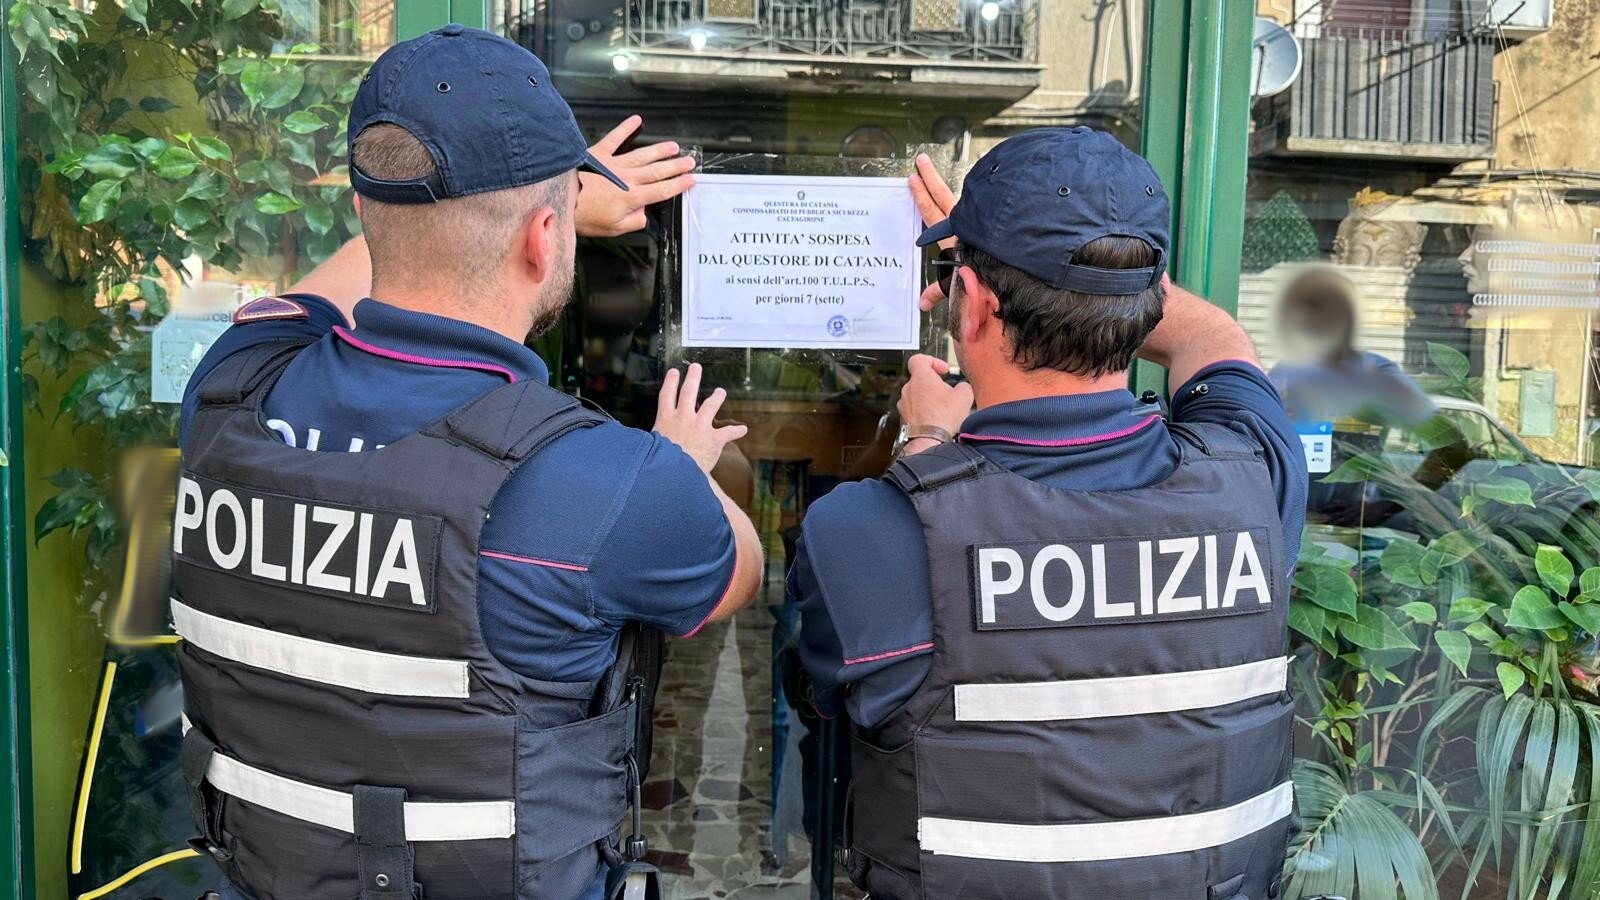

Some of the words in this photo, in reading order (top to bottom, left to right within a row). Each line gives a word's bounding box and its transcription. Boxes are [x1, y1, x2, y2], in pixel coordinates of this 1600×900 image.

[733, 207, 789, 215] COMMISSARIATO
[730, 233, 804, 244] ATTIVITA’
[808, 234, 871, 245] SOSPESA
[698, 253, 728, 265] DAL
[732, 254, 810, 267] QUESTORE
[814, 255, 829, 267] DI
[833, 256, 903, 269] CATANIA,
[725, 275, 734, 285] ai
[737, 275, 761, 285] sensi
[755, 295, 772, 305] per
[774, 294, 804, 305] giorni
[806, 294, 812, 304] 7
[814, 294, 844, 305] (sette)
[173, 476, 427, 606] POLIZIA
[978, 531, 1272, 624] POLIZIA
